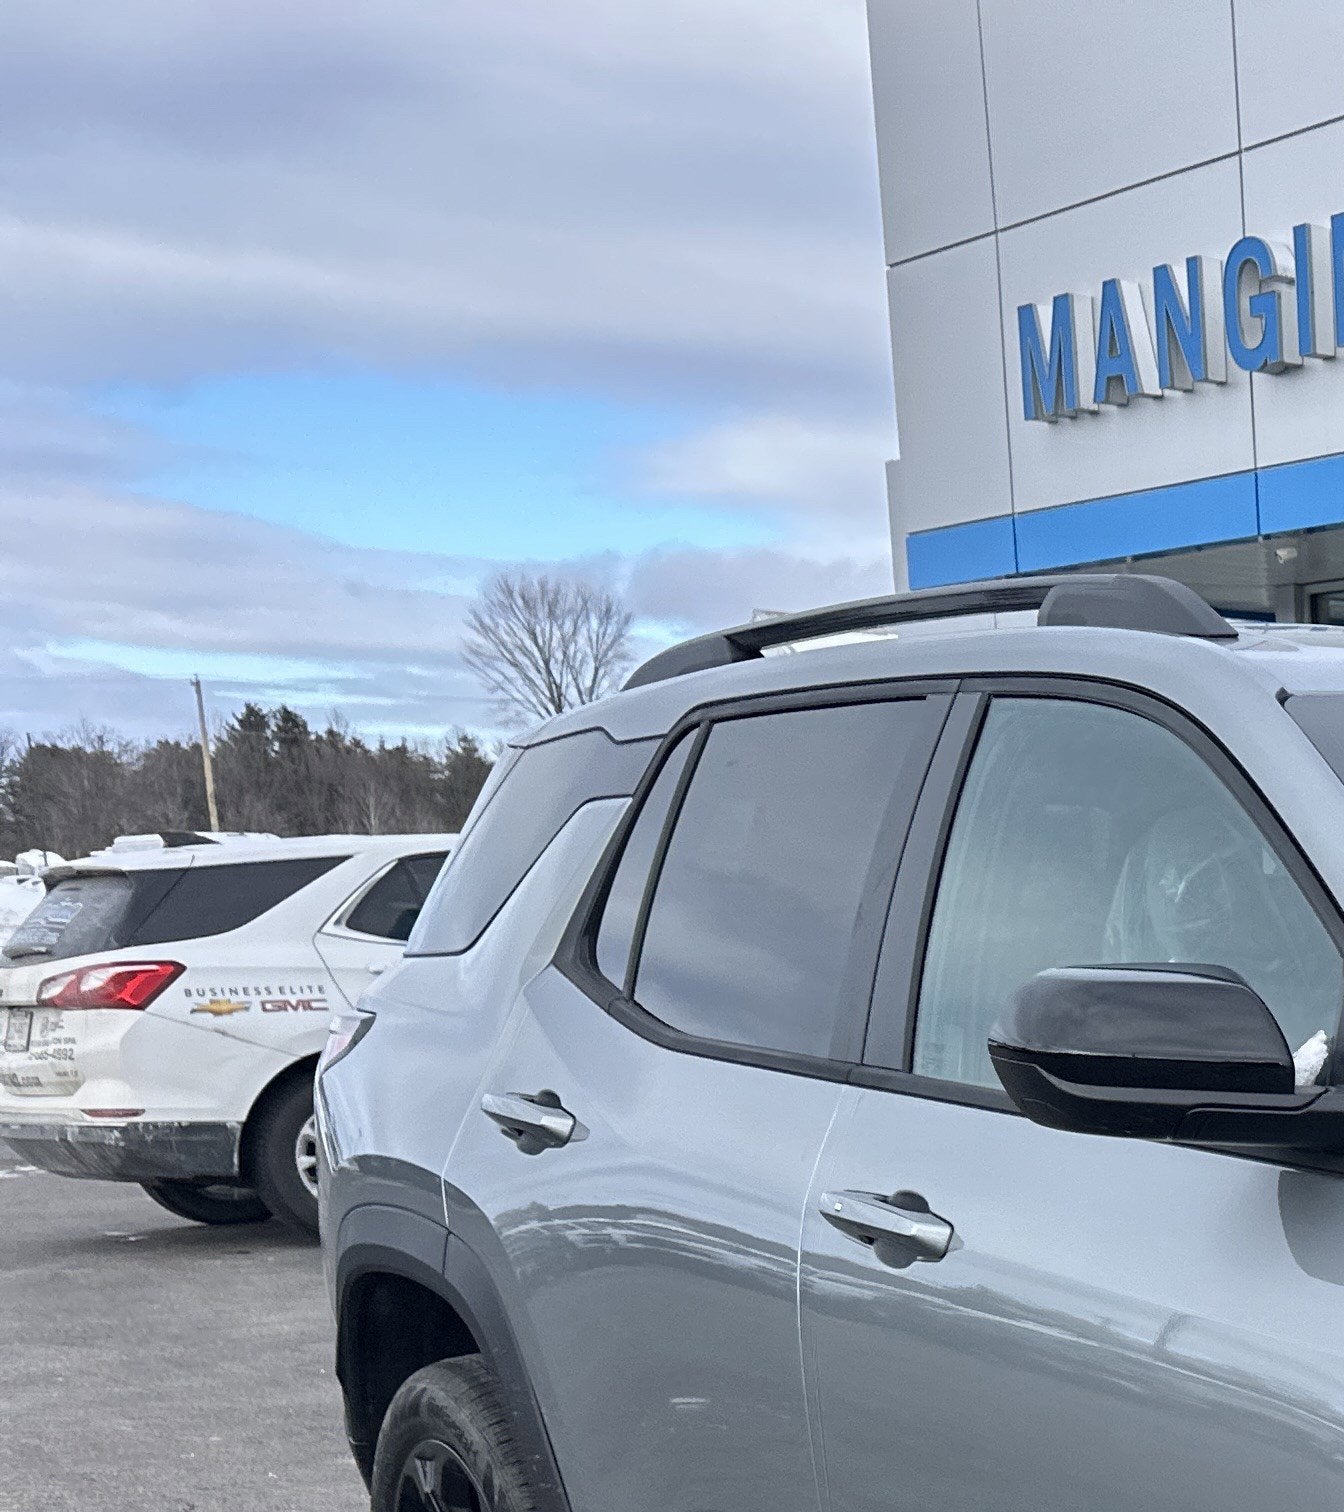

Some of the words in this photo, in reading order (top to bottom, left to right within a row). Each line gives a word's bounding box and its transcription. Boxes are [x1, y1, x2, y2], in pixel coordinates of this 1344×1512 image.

[184, 986, 272, 998] BUSINESS
[278, 984, 326, 995] ELITE
[260, 998, 330, 1013] GMC
